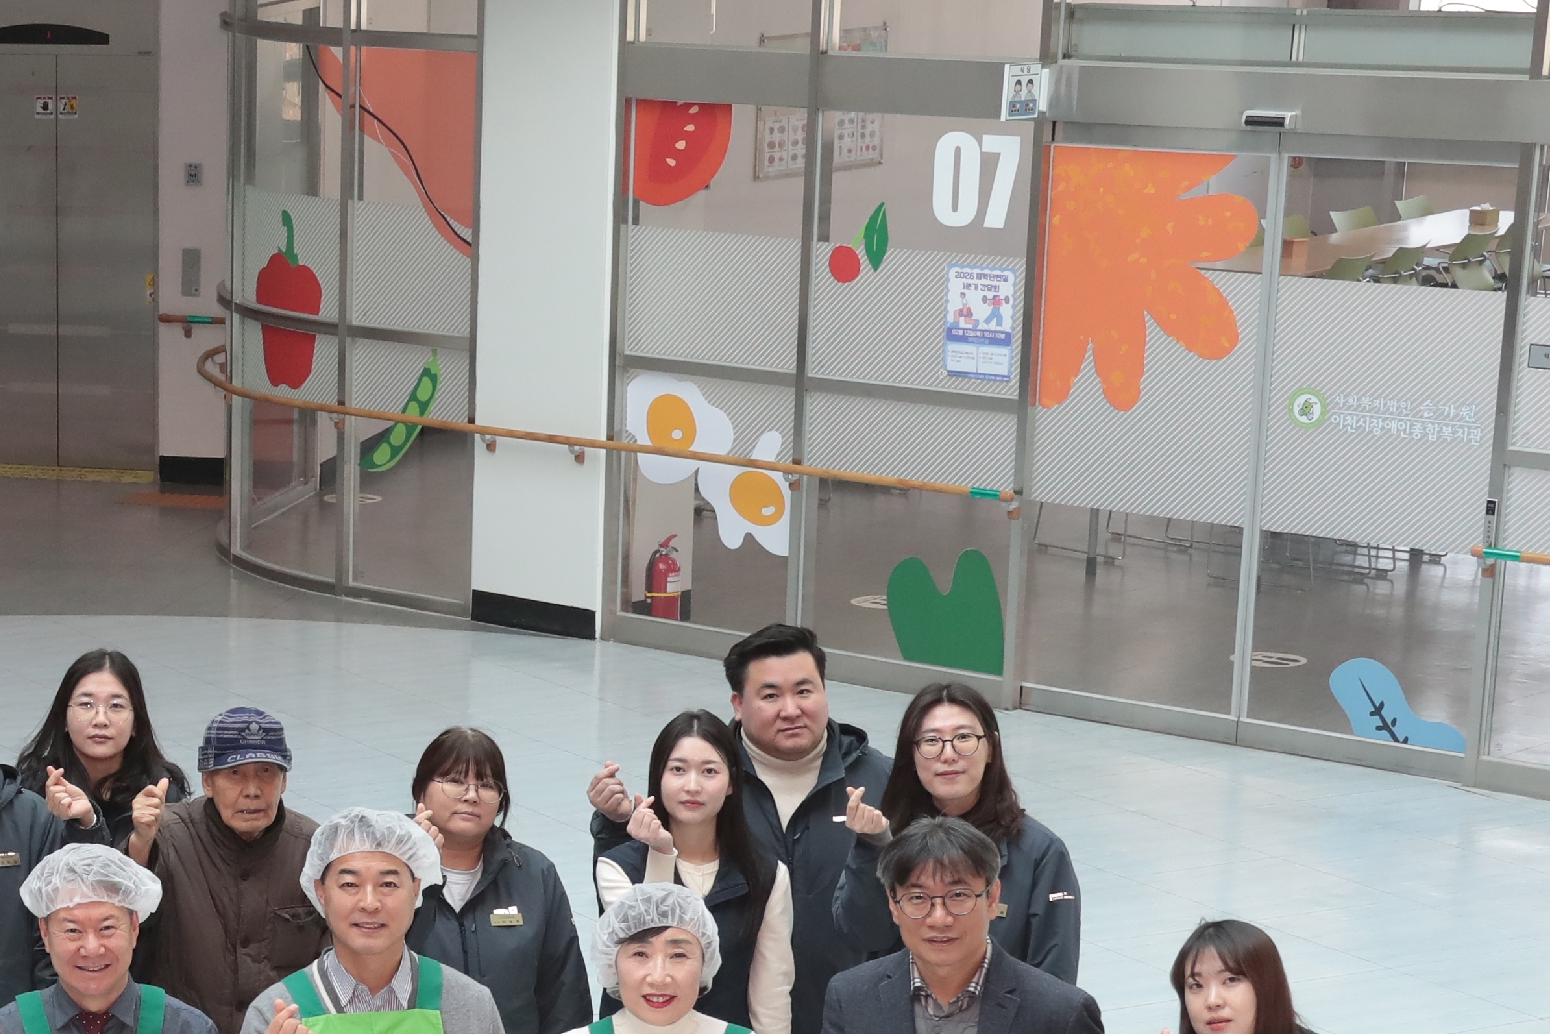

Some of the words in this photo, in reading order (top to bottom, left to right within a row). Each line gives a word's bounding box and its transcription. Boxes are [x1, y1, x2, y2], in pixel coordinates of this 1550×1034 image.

[931, 131, 1021, 228] 07
[955, 271, 975, 280] 2026
[1333, 394, 1412, 414] 사회복지법인
[1419, 399, 1476, 422] 승가원
[1331, 413, 1483, 446] 이천시장애인종합복지관
